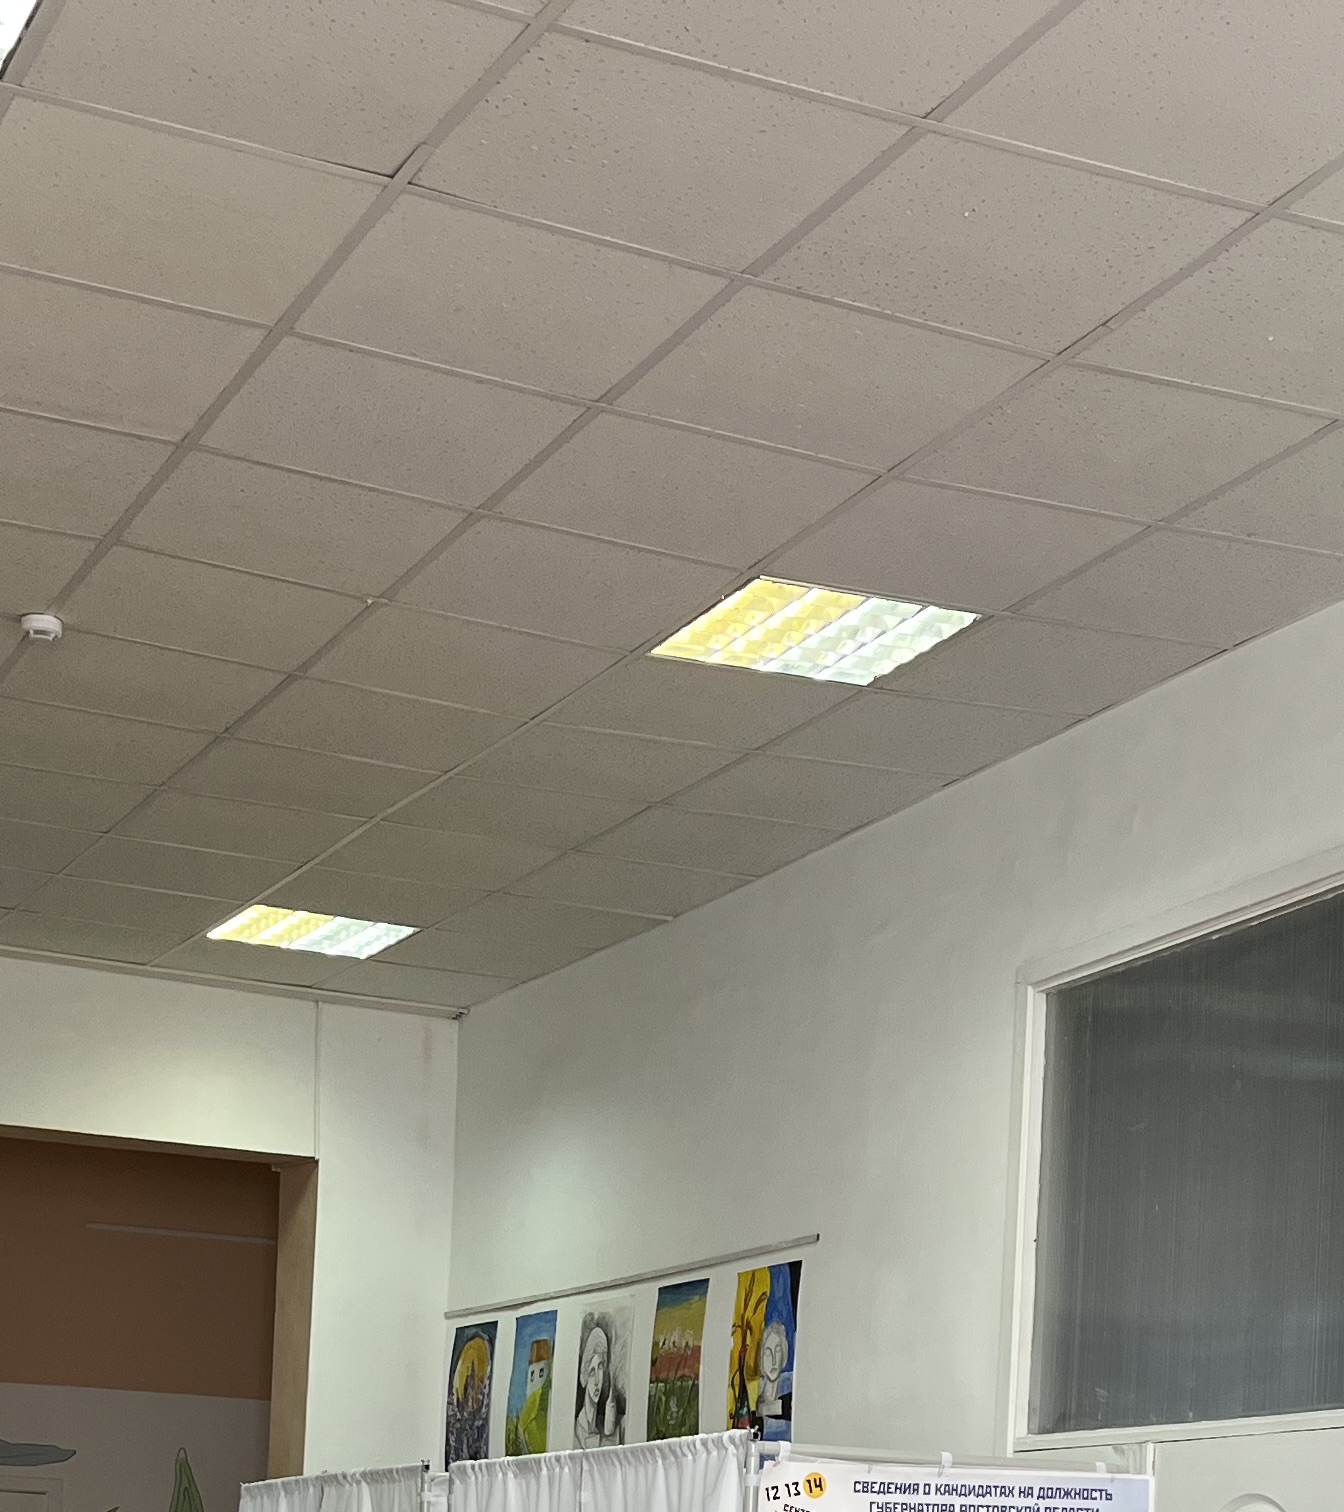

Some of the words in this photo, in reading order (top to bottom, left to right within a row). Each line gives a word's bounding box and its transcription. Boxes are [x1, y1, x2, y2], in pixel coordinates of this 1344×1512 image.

[765, 1485, 781, 1501] 12
[784, 1481, 801, 1497] 13
[806, 1477, 824, 1494] 14
[853, 1480, 919, 1496] СВЕДЕНИЯ
[923, 1483, 931, 1496] О
[934, 1482, 1015, 1499] КАНДИДАТАХ
[1018, 1485, 1034, 1499] НА
[1036, 1486, 1113, 1502] ДОЛЖНОСТЬ
